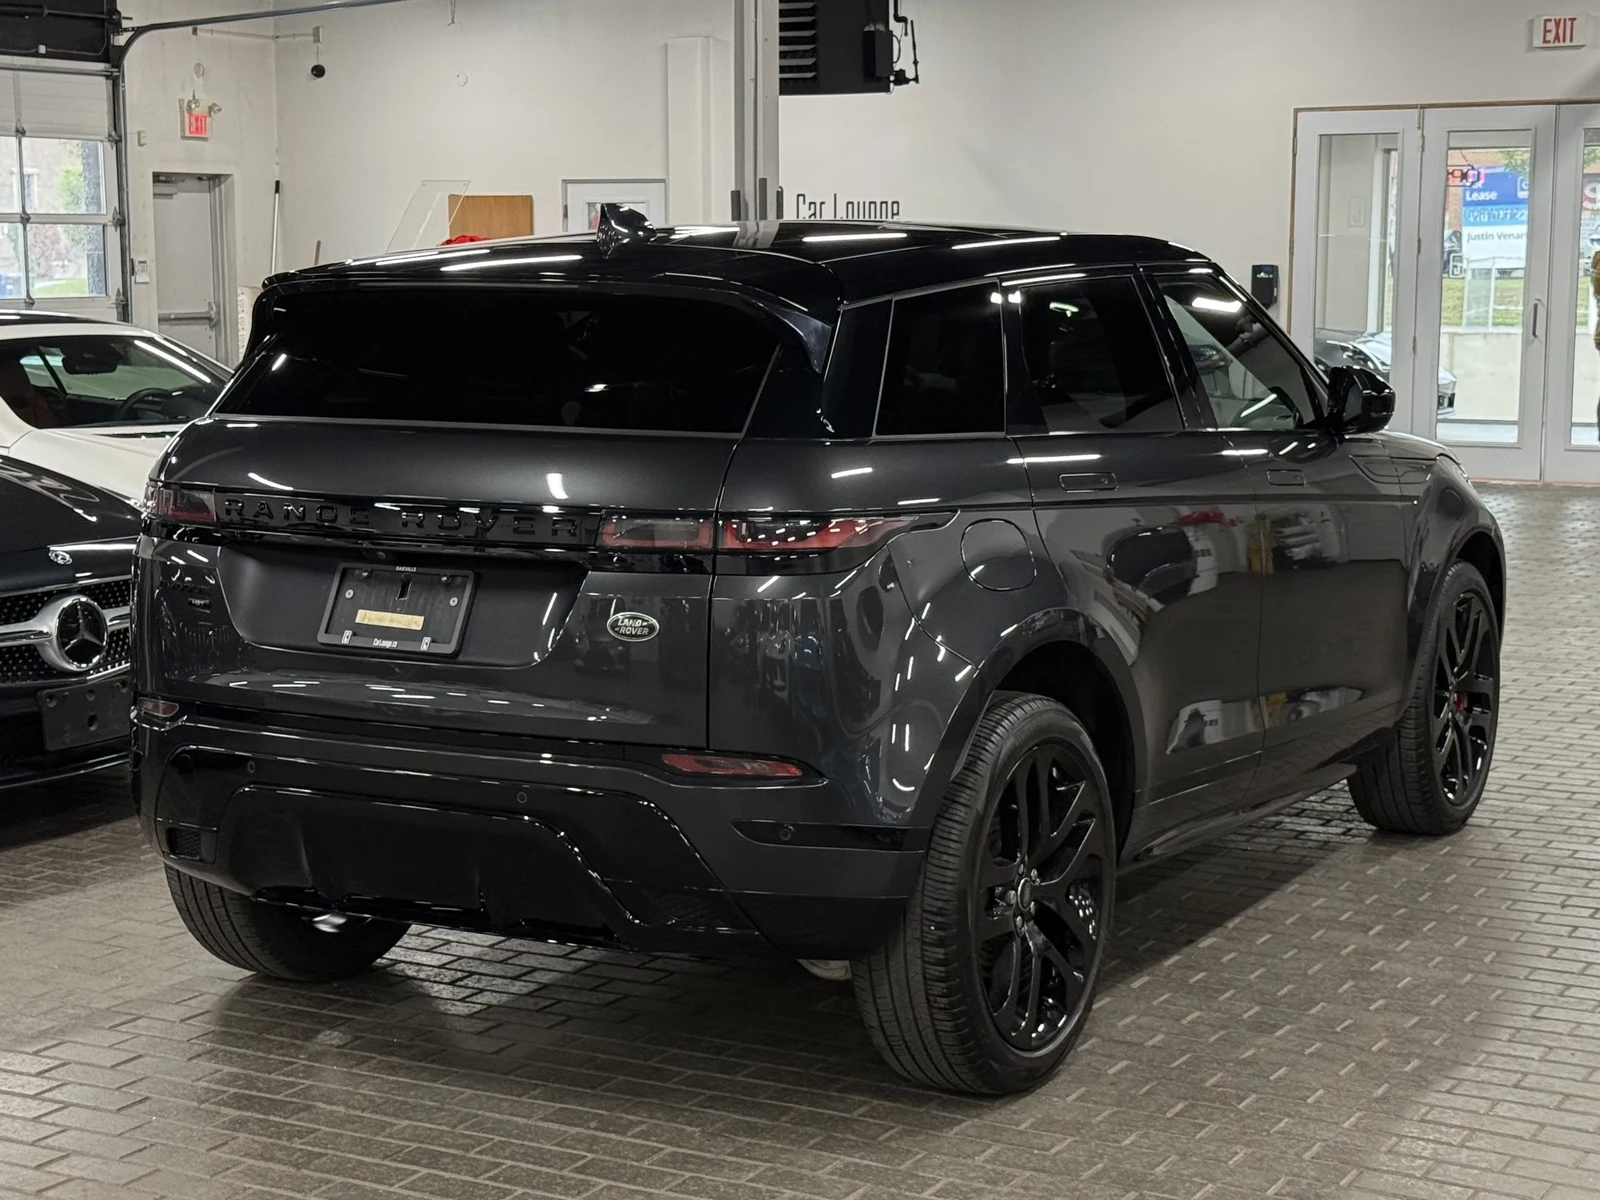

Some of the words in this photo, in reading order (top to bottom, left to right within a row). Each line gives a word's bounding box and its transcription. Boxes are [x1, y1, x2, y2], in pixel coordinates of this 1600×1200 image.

[1542, 17, 1577, 44] EXIT
[188, 114, 208, 135] EXIT
[1466, 190, 1498, 201] Lease
[796, 193, 826, 219] Car
[1467, 231, 1495, 243] Justin
[1497, 231, 1527, 241] Venar
[224, 499, 370, 526] RANGE
[402, 511, 578, 537] ROVER
[617, 617, 643, 627] LAND
[619, 626, 649, 635] ROVER
